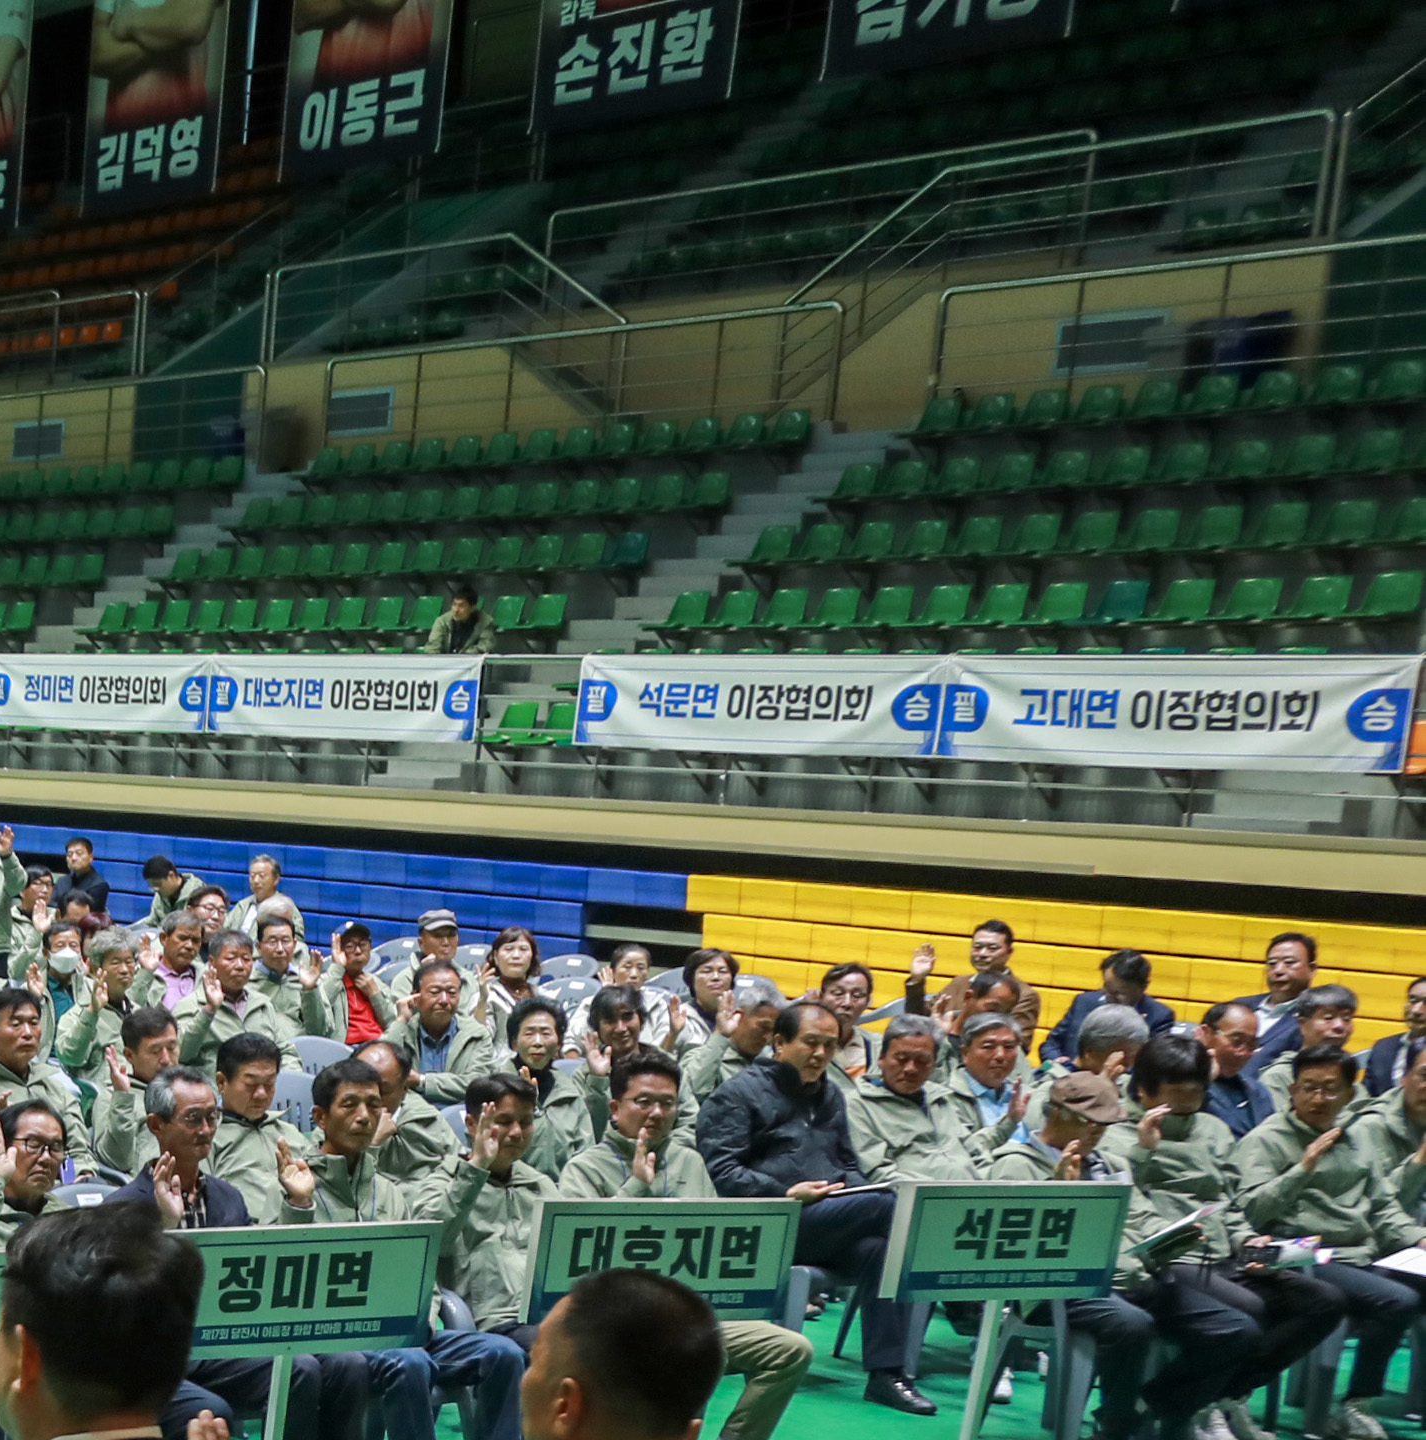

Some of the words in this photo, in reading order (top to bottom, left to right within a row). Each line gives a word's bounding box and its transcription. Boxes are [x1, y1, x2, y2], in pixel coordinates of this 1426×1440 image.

[552, 7, 715, 106] 손진환
[298, 68, 424, 151] 이동근
[96, 115, 203, 192] 김덕영
[24, 674, 74, 704] 정미면
[78, 675, 167, 706] 이장협의회
[243, 678, 324, 710] 대호지면
[330, 678, 439, 713] 이장협의회
[637, 681, 720, 719] 석문면
[727, 683, 874, 722] 이장협의회
[1013, 687, 1118, 729] 고대면
[1130, 689, 1322, 733] 이장협의회
[568, 1225, 762, 1279] 대호지면
[954, 1207, 1077, 1260] 석문면
[218, 1251, 373, 1313] 정미면
